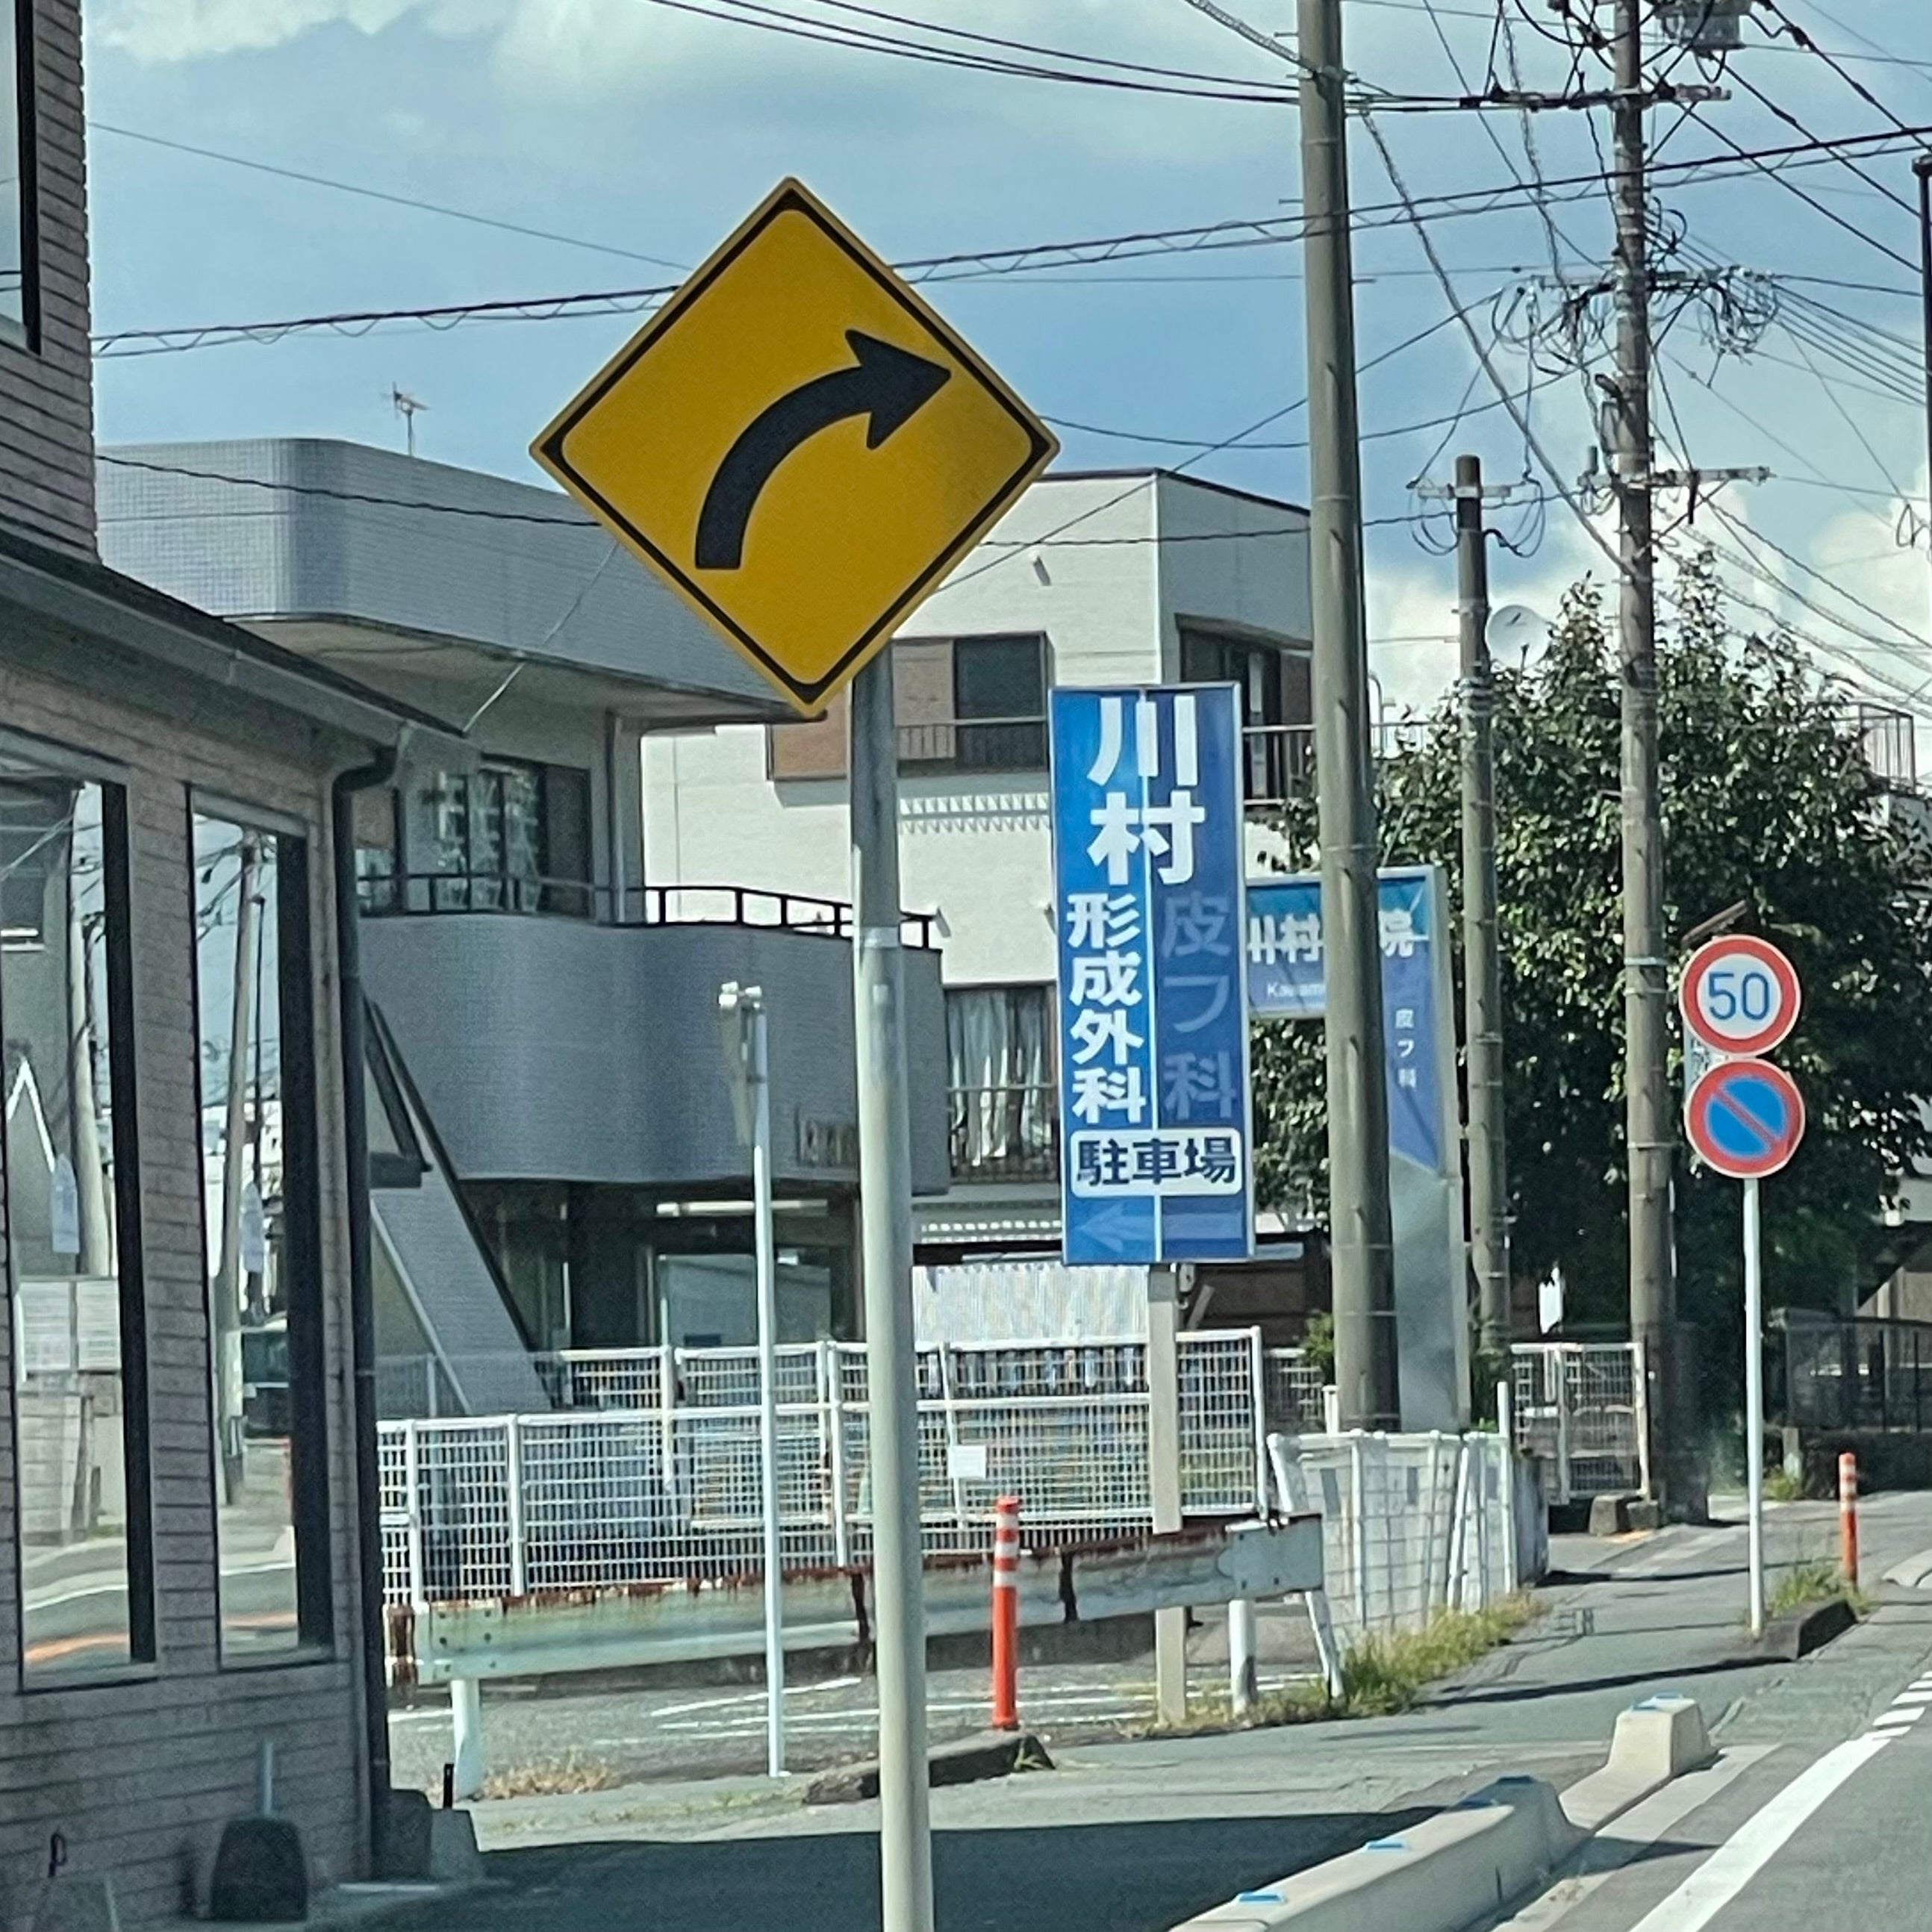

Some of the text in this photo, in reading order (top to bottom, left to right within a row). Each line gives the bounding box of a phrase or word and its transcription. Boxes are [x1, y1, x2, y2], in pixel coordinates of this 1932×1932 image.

[1088, 696, 1205, 885] 川村
[1067, 893, 1147, 1124] 形成外科
[1162, 891, 1237, 1120] 皮フ科
[1708, 972, 1770, 1020] 50
[1077, 1136, 1236, 1186] 駐車場
